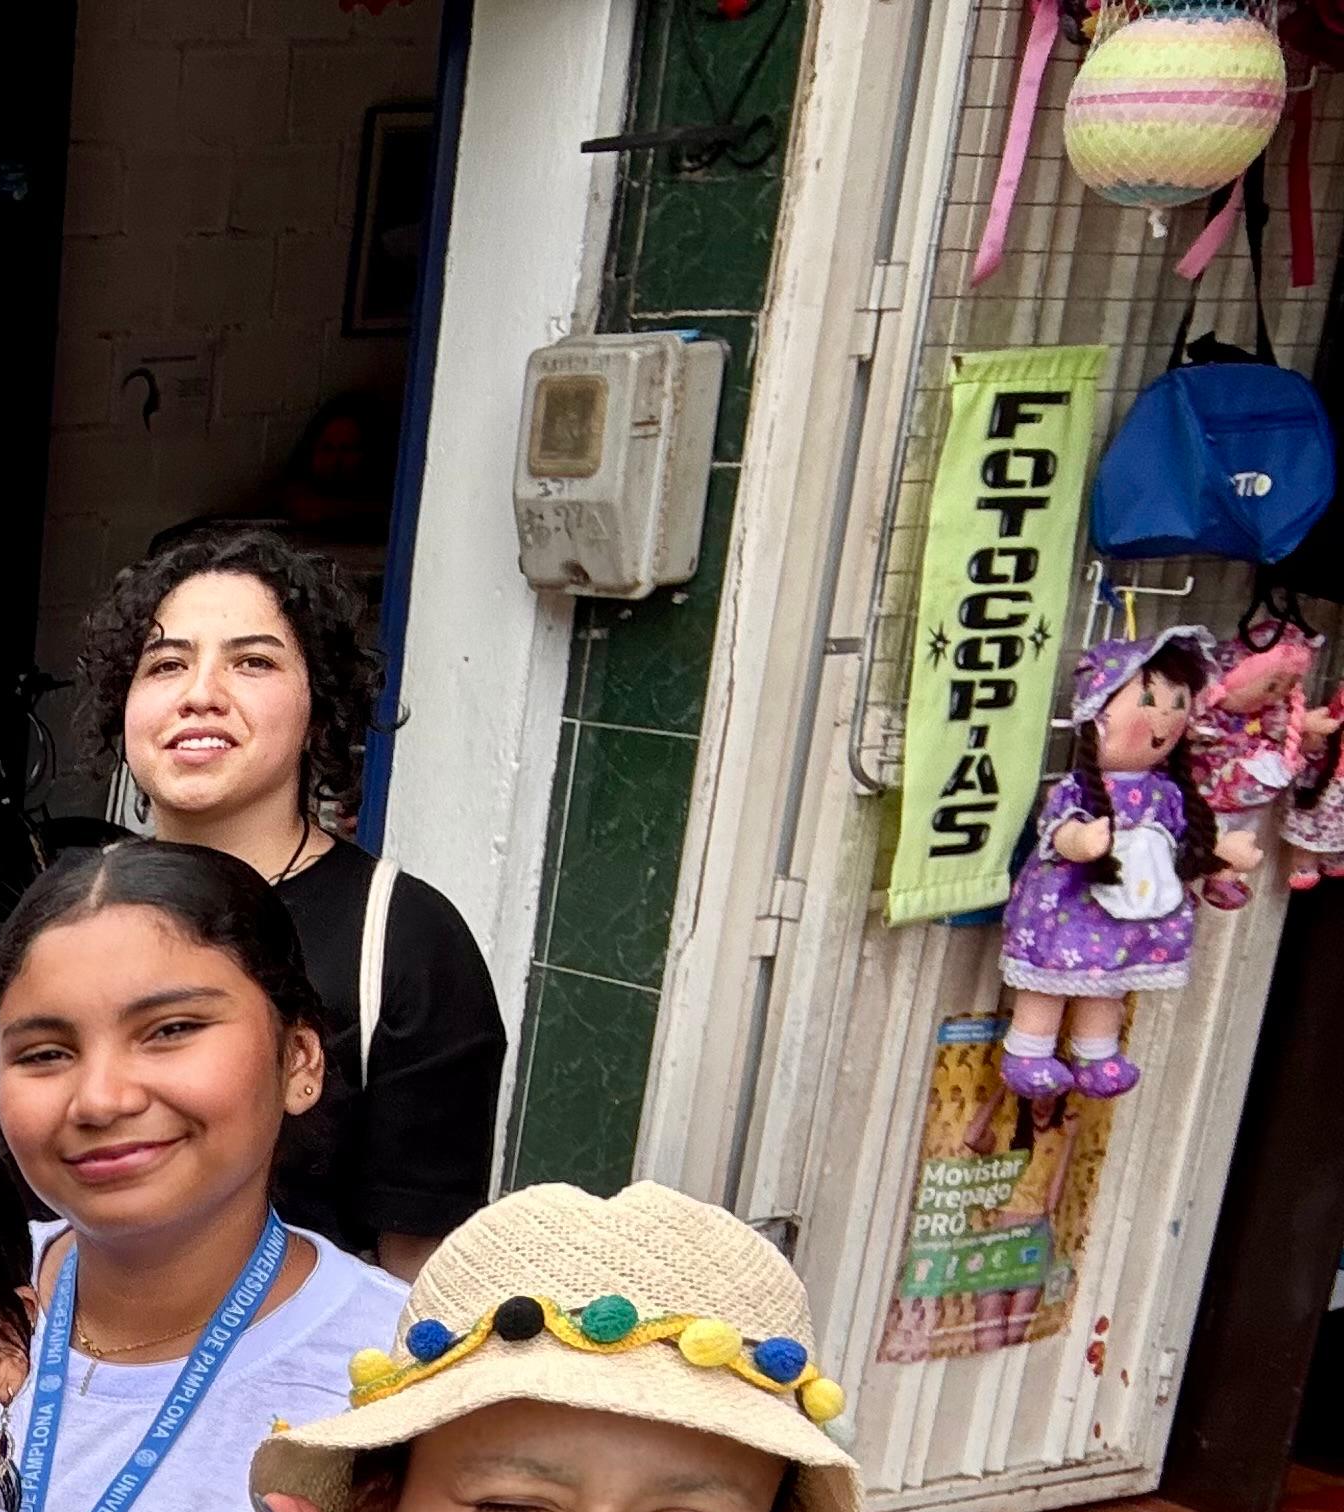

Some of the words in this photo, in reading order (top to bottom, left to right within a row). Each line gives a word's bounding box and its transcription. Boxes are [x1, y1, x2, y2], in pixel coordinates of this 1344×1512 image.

[928, 391, 1072, 858] FOTOCOPIAS
[923, 1158, 1023, 1188] Movistar
[918, 1181, 1012, 1210] Prepago
[913, 1208, 967, 1238] PRO
[221, 1224, 286, 1329] UNIVERSIDAD
[210, 1325, 232, 1352] DE
[151, 1349, 214, 1439] PAMPLONA
